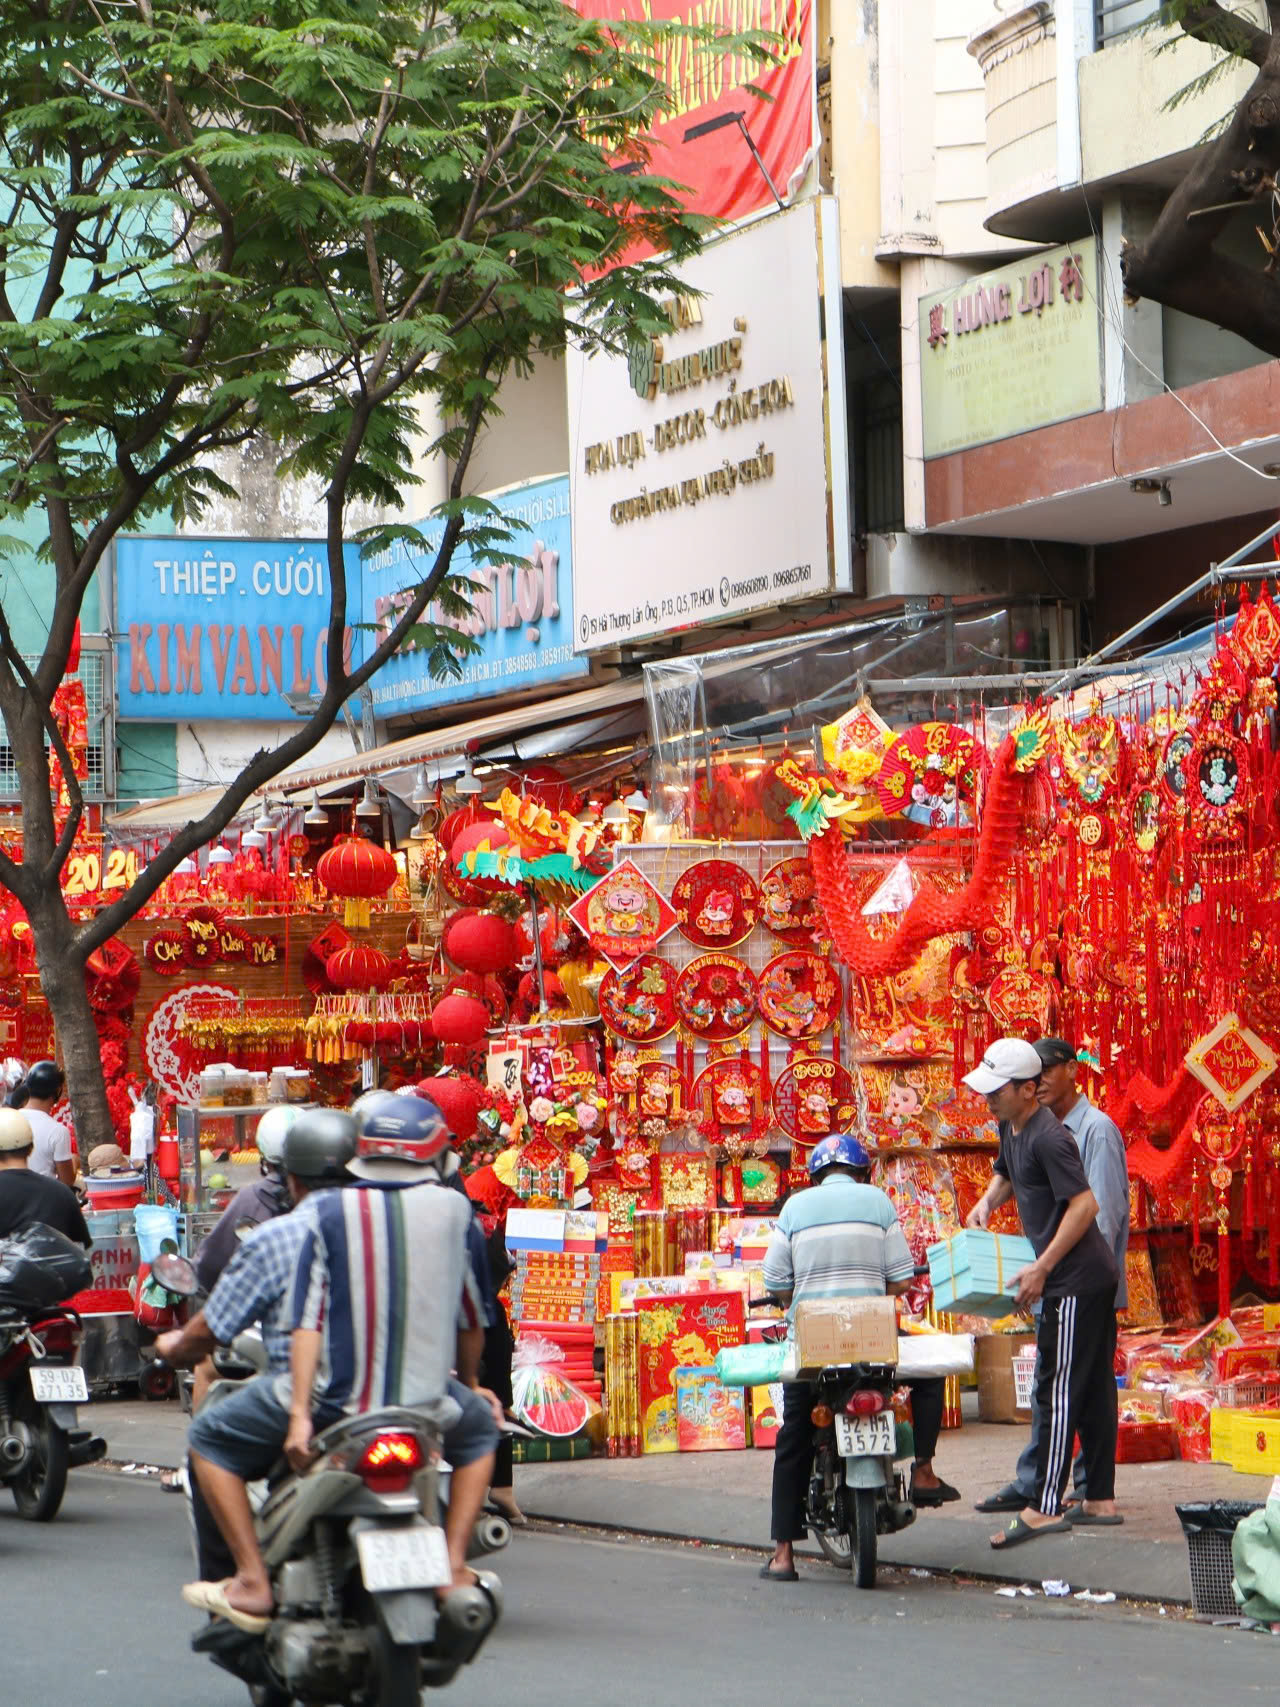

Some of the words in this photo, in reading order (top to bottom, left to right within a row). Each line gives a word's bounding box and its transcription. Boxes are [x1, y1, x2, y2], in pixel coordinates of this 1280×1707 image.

[655, 407, 707, 453] DECOR
[252, 546, 334, 597] CƯỚI
[599, 614, 608, 631] Hải
[609, 609, 631, 632] Thượng
[645, 602, 658, 622] Ông
[691, 591, 715, 610] TP.HCM
[128, 622, 206, 695] KIM
[65, 853, 100, 895] 20
[102, 849, 139, 889] 24
[844, 1434, 891, 1453] 3572
